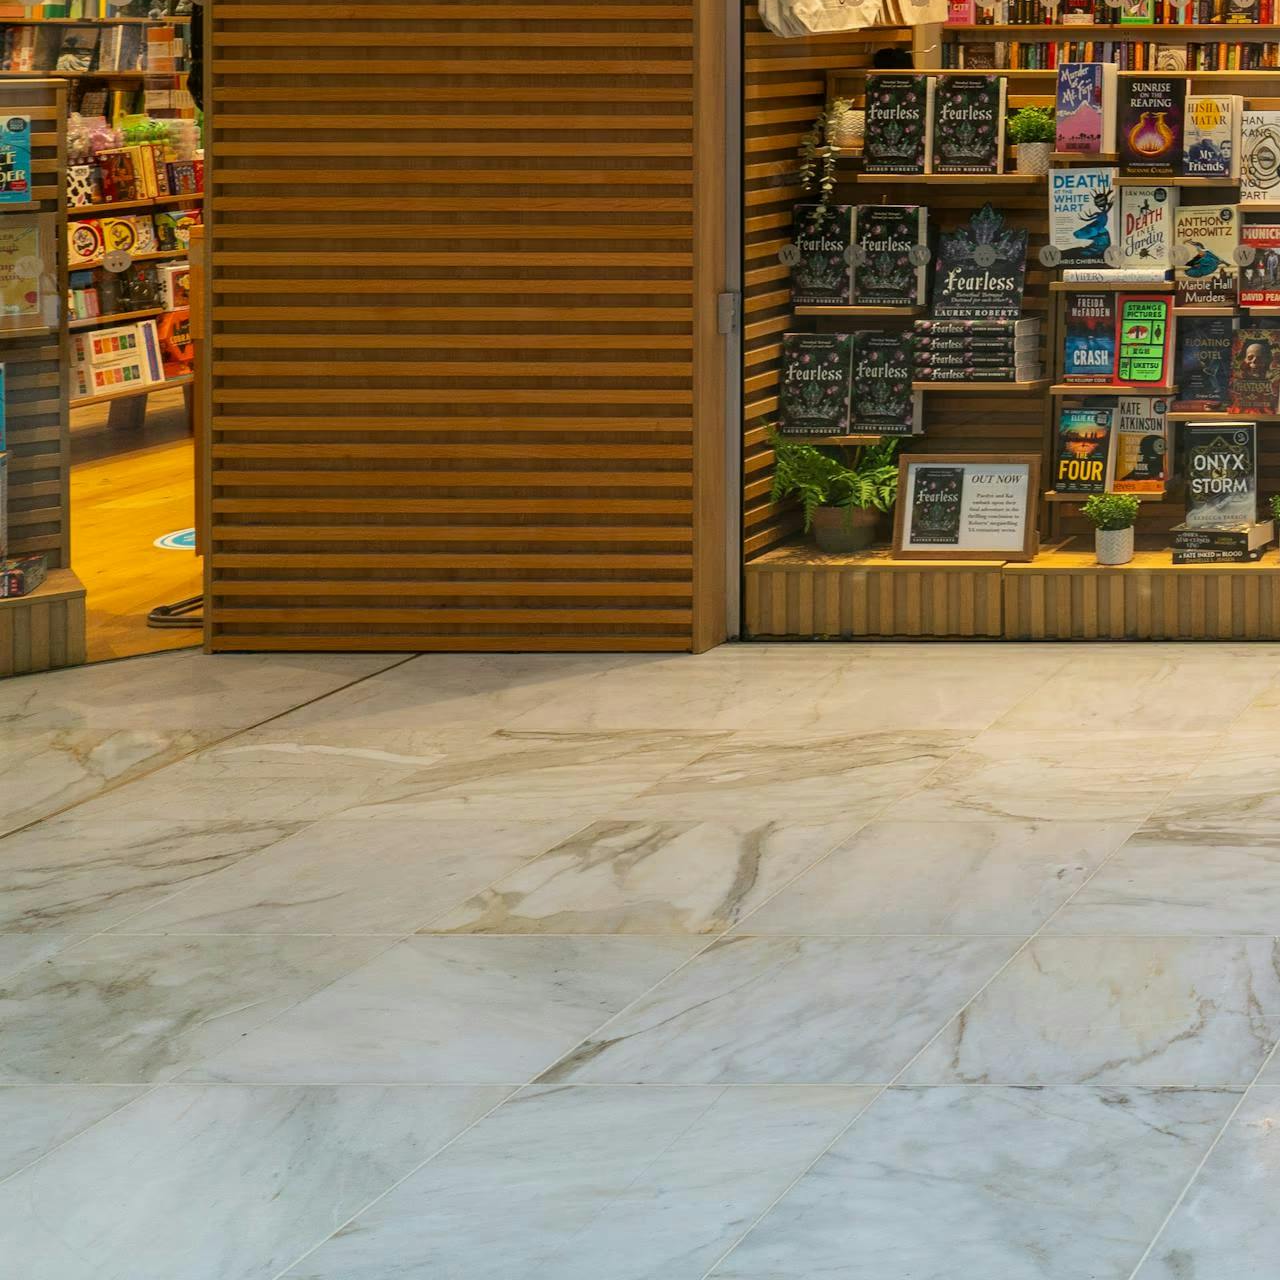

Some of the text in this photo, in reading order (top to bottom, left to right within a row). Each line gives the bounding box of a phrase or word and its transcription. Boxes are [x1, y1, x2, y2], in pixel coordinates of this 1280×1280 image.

[1132, 82, 1171, 93] SUNRISE
[1130, 98, 1172, 108] REAPING
[1187, 102, 1230, 113] HISHAM
[1190, 114, 1227, 126] MATAR
[1241, 116, 1265, 125] HAN
[1241, 128, 1272, 138] KANG
[1198, 149, 1214, 162] My
[1241, 154, 1258, 164] WE
[1188, 160, 1224, 172] Friends
[1241, 166, 1256, 176] DO
[1053, 174, 1110, 189] DEATH
[1241, 179, 1262, 188] NOT
[1053, 194, 1090, 203] WHITE
[1241, 191, 1268, 201] PART
[1053, 203, 1084, 213] HART
[1125, 207, 1163, 236] DEATH
[1177, 227, 1233, 238] HOROWITZ
[1125, 231, 1165, 257] Jardin
[1178, 276, 1233, 291] Marble Hall
[1077, 297, 1105, 308] FREIDA
[1185, 291, 1225, 304] Murders
[1241, 293, 1264, 303] DAVID
[934, 309, 1019, 317] LAUREN ROBERTS
[1071, 307, 1111, 318] McFADDEN
[1127, 304, 1162, 312] STRANGE
[1127, 311, 1162, 319] PICTURES
[1073, 350, 1109, 366] CRASH
[1133, 361, 1159, 369] UKETSU
[1120, 402, 1142, 416] KATE
[1119, 417, 1163, 432] ATKINSON
[1193, 453, 1245, 472] ONYX
[1058, 459, 1104, 482] FOUR
[971, 474, 1023, 484] OUT NOW
[1191, 478, 1248, 494] STORM
